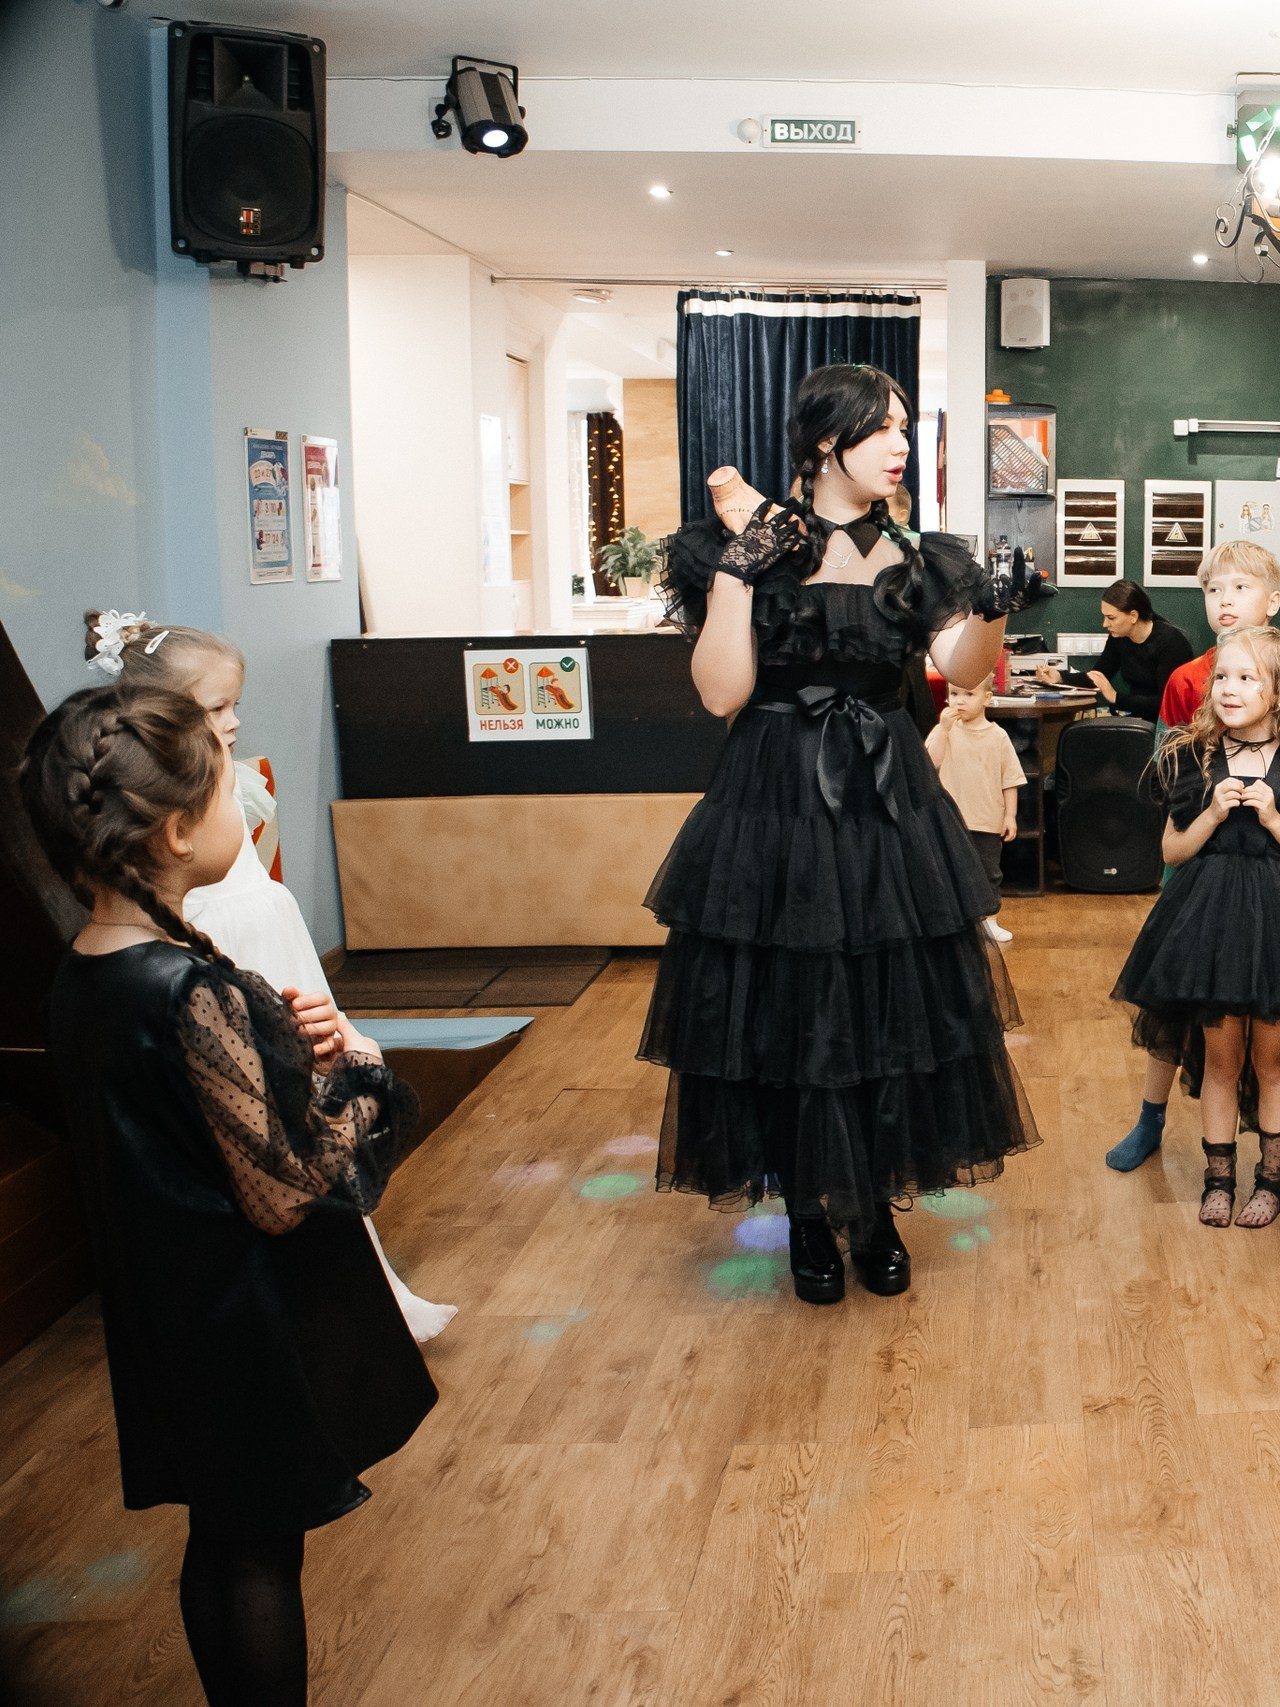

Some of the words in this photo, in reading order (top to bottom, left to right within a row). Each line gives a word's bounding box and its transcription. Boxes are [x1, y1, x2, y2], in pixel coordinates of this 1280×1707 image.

[774, 123, 853, 141] ВЫХОД
[480, 719, 524, 731] НЕЛЬЗЯ
[536, 718, 580, 730] МОЖНО
